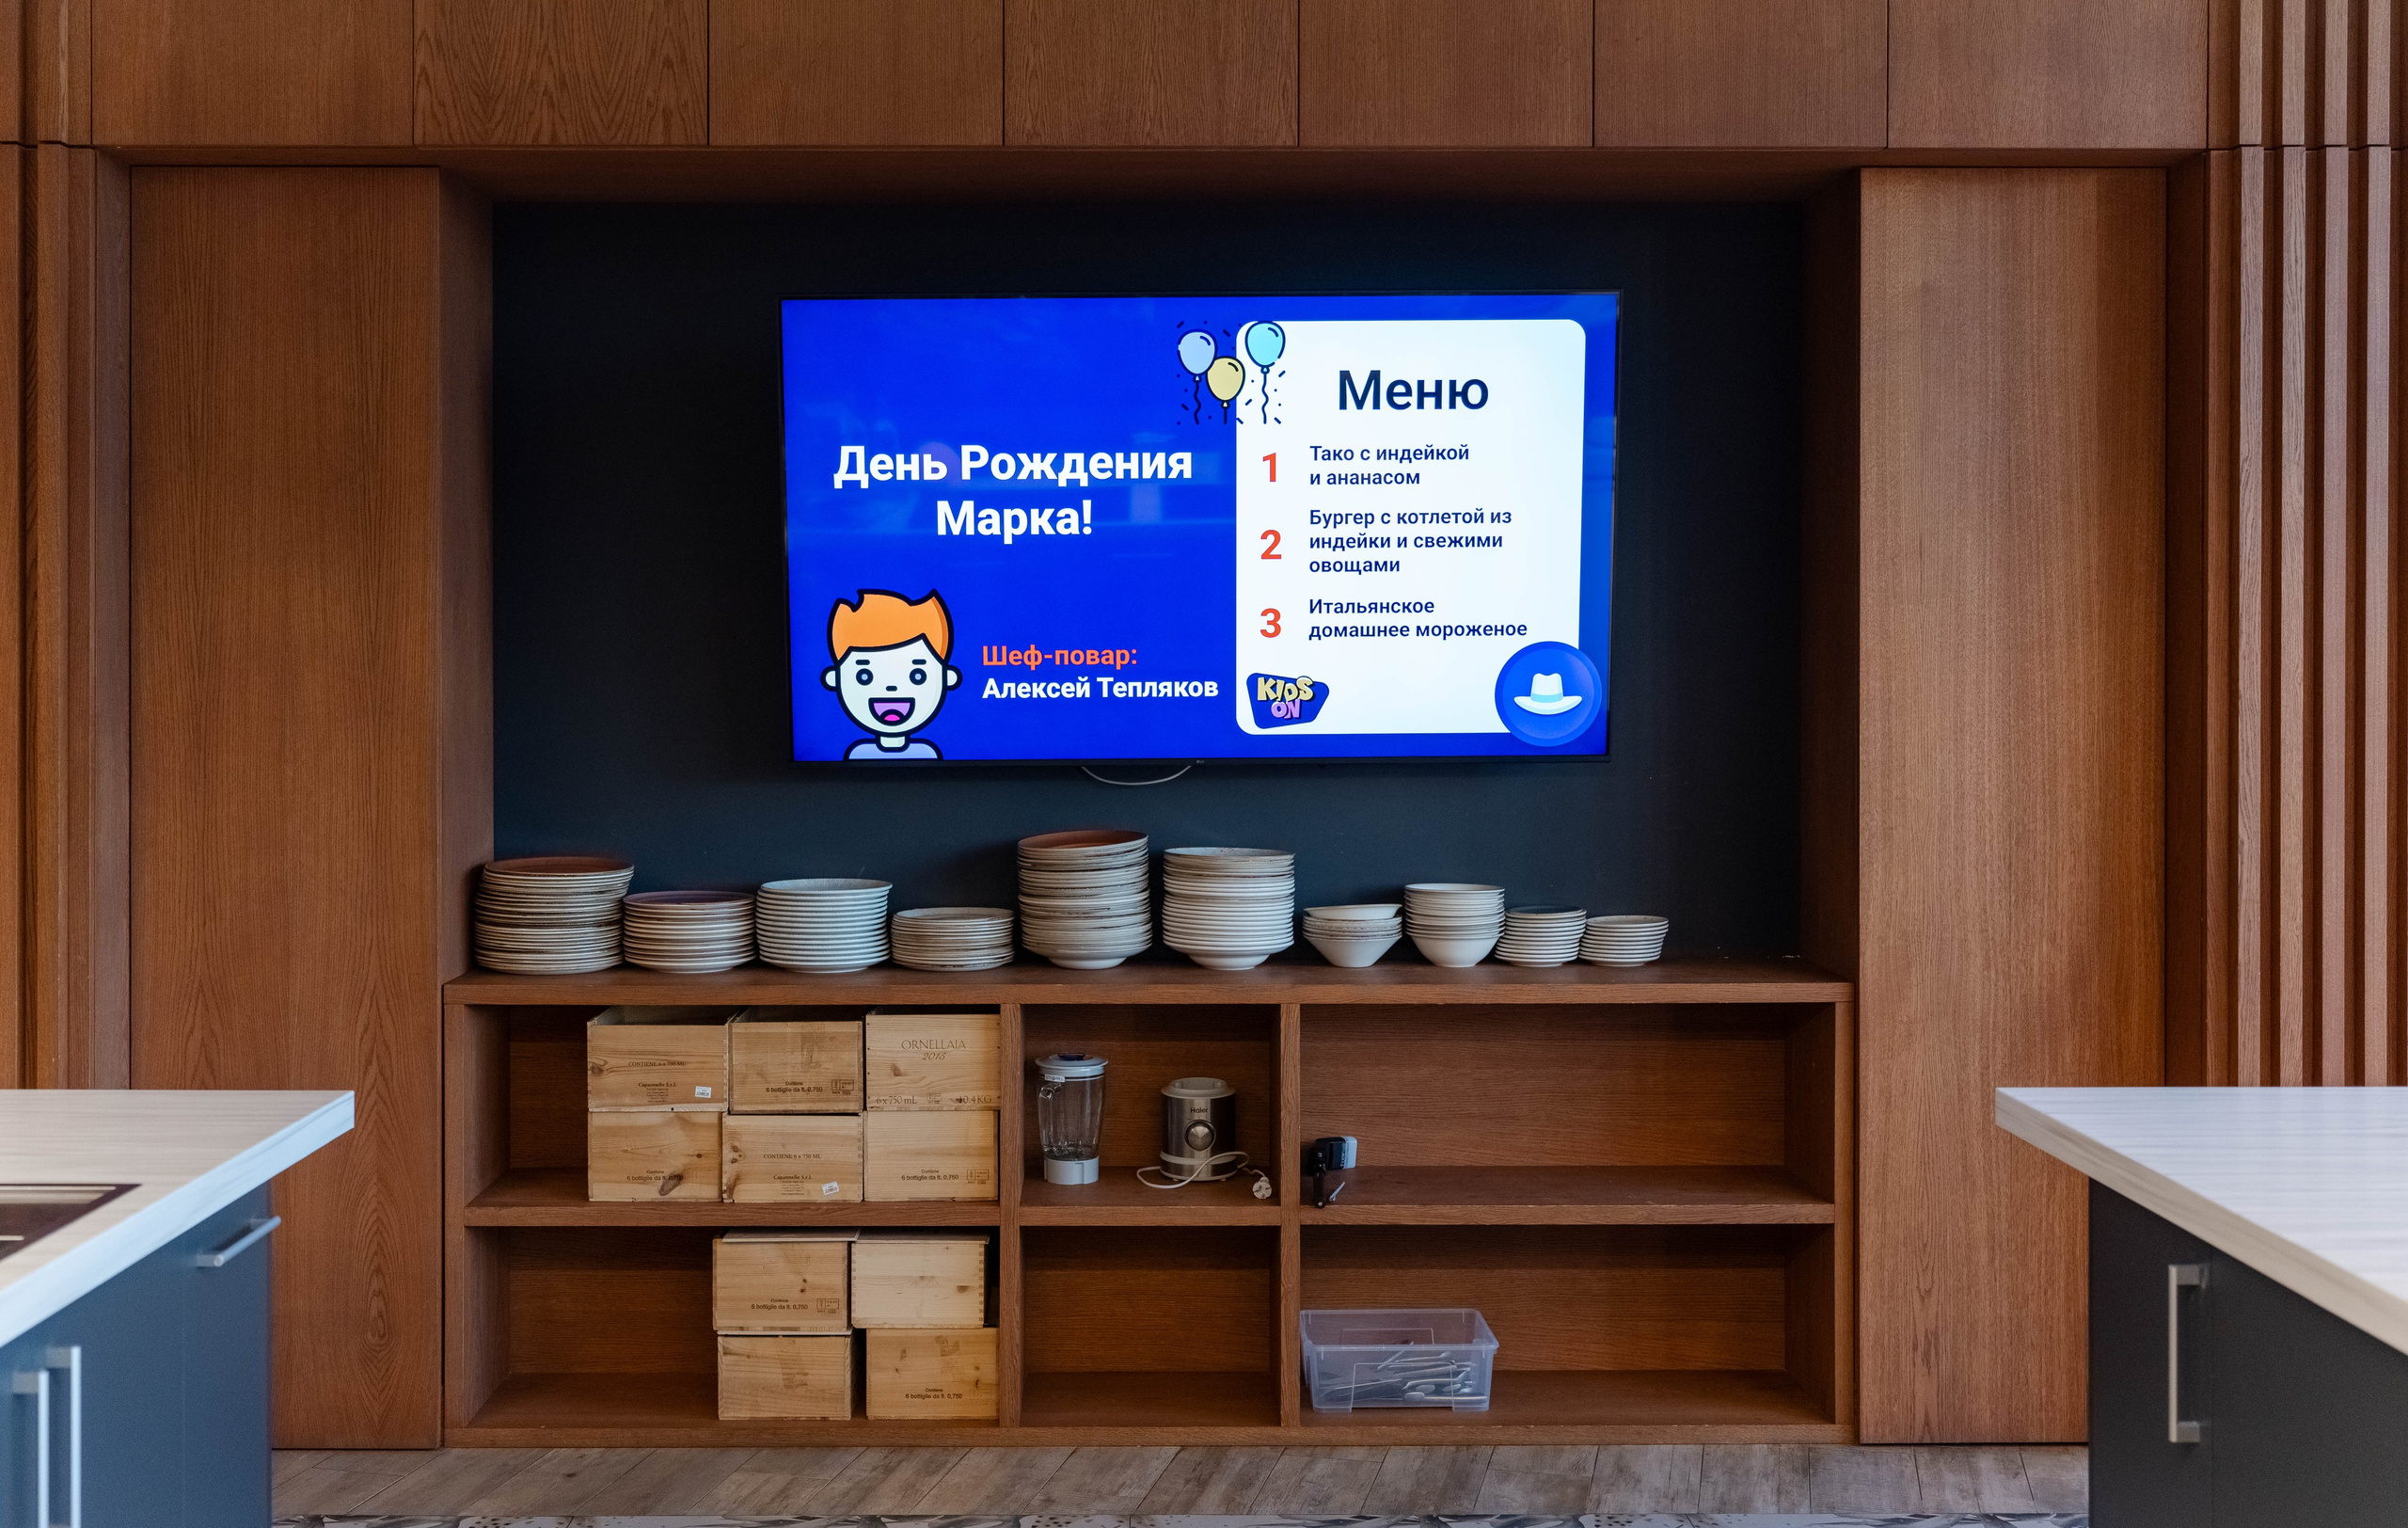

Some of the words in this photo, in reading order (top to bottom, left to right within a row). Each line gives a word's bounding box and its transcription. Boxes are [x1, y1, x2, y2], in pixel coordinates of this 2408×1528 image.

[1339, 370, 1489, 411] Меню
[1309, 445, 1354, 461] Тако
[1360, 448, 1370, 461] с
[1376, 444, 1469, 464] индейкой
[833, 445, 948, 489] День
[960, 444, 1193, 487] Рождения
[1262, 452, 1277, 483] 1
[1309, 473, 1321, 485] и
[1326, 472, 1420, 485] ананасом
[936, 500, 1093, 545] Марка!
[1309, 509, 1375, 529] Бургер
[1380, 512, 1391, 525] с
[1397, 507, 1484, 525] котлетой
[1490, 511, 1513, 524] из
[1260, 529, 1282, 560] 2
[1309, 533, 1391, 552] индейки
[1397, 536, 1408, 549] и
[1413, 535, 1503, 549] свежими
[1308, 560, 1401, 576] овощами
[1309, 598, 1435, 614] Итальянское
[1259, 608, 1282, 639] 3
[1308, 625, 1410, 641] домашнее
[1416, 624, 1528, 641] мороженое
[982, 644, 1137, 671] Шеф-повар:
[982, 676, 1091, 699] Алексей
[1097, 676, 1219, 698] Тепляков
[1257, 676, 1314, 702] KIDS
[1271, 698, 1301, 720] ON
[901, 1039, 967, 1050] ORNELLAIA
[903, 1095, 918, 1105] mL
[976, 1094, 992, 1104] KG
